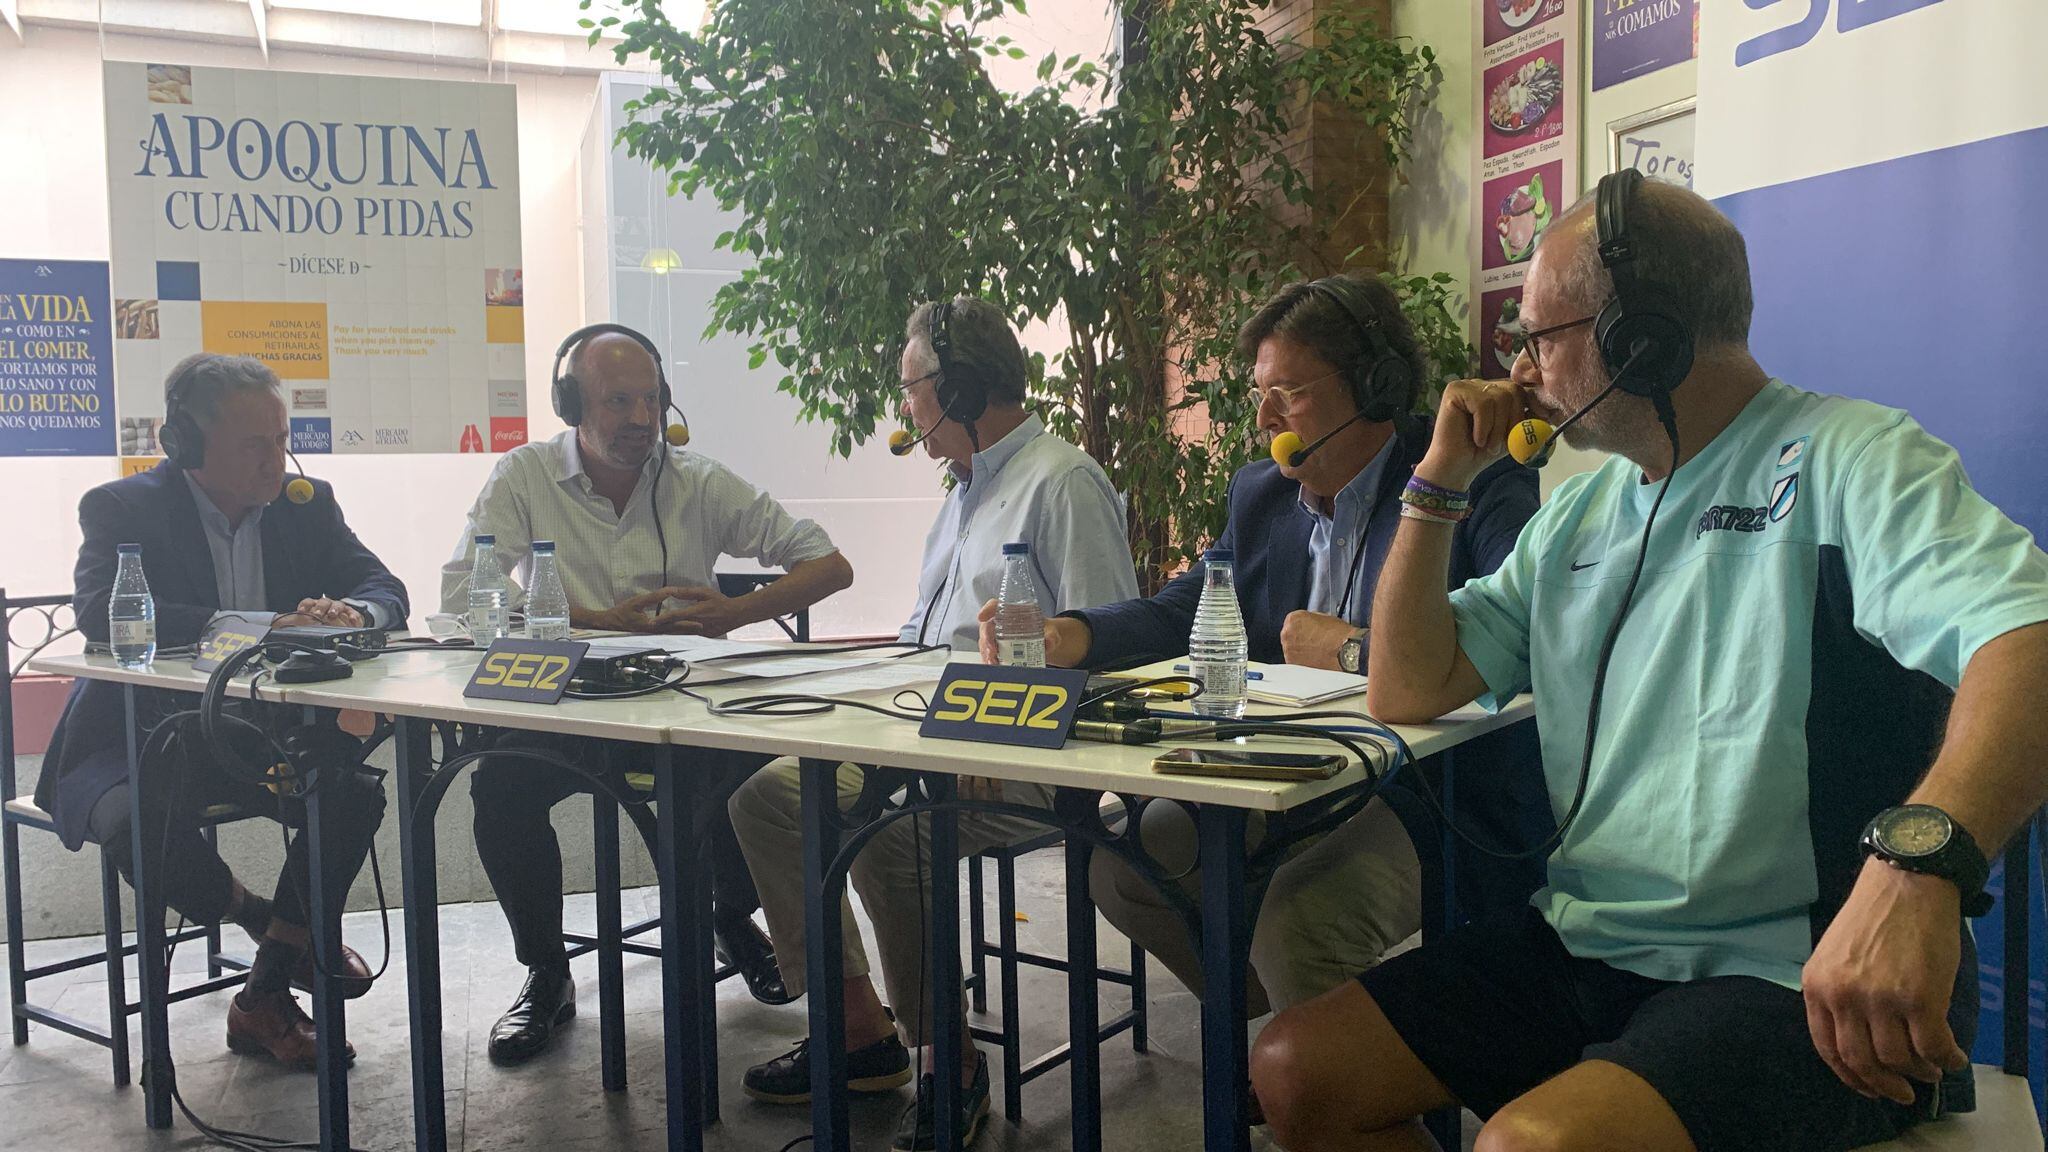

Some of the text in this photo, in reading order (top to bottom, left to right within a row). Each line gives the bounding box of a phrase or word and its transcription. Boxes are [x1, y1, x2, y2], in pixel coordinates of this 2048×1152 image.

[1617, 0, 1681, 37] COMAMOS
[133, 112, 498, 191] APOQUINA
[1625, 137, 1694, 179] Toros
[165, 191, 474, 239] CUANDO PIDAS
[16, 294, 94, 323] VIDA
[16, 324, 76, 338] COMO EN
[268, 319, 322, 329] ABONA LAS
[333, 325, 350, 335] Pay
[366, 327, 386, 335] your
[388, 326, 409, 335] food
[410, 326, 429, 335] and
[227, 329, 322, 340] CONSUMICIONES AL
[359, 338, 377, 346] you
[0, 340, 96, 363] EL COMER,
[282, 352, 323, 361] GRACIAS
[363, 348, 381, 356] you
[71, 362, 98, 376] POR
[0, 378, 97, 391] LO SANO Y CON
[0, 393, 100, 412] LO BUENO
[0, 415, 101, 431] NOS QUEDAMOS
[305, 423, 315, 432] EL
[293, 431, 330, 441] MERCADO
[475, 652, 570, 690] SER
[934, 679, 1068, 731] SER
